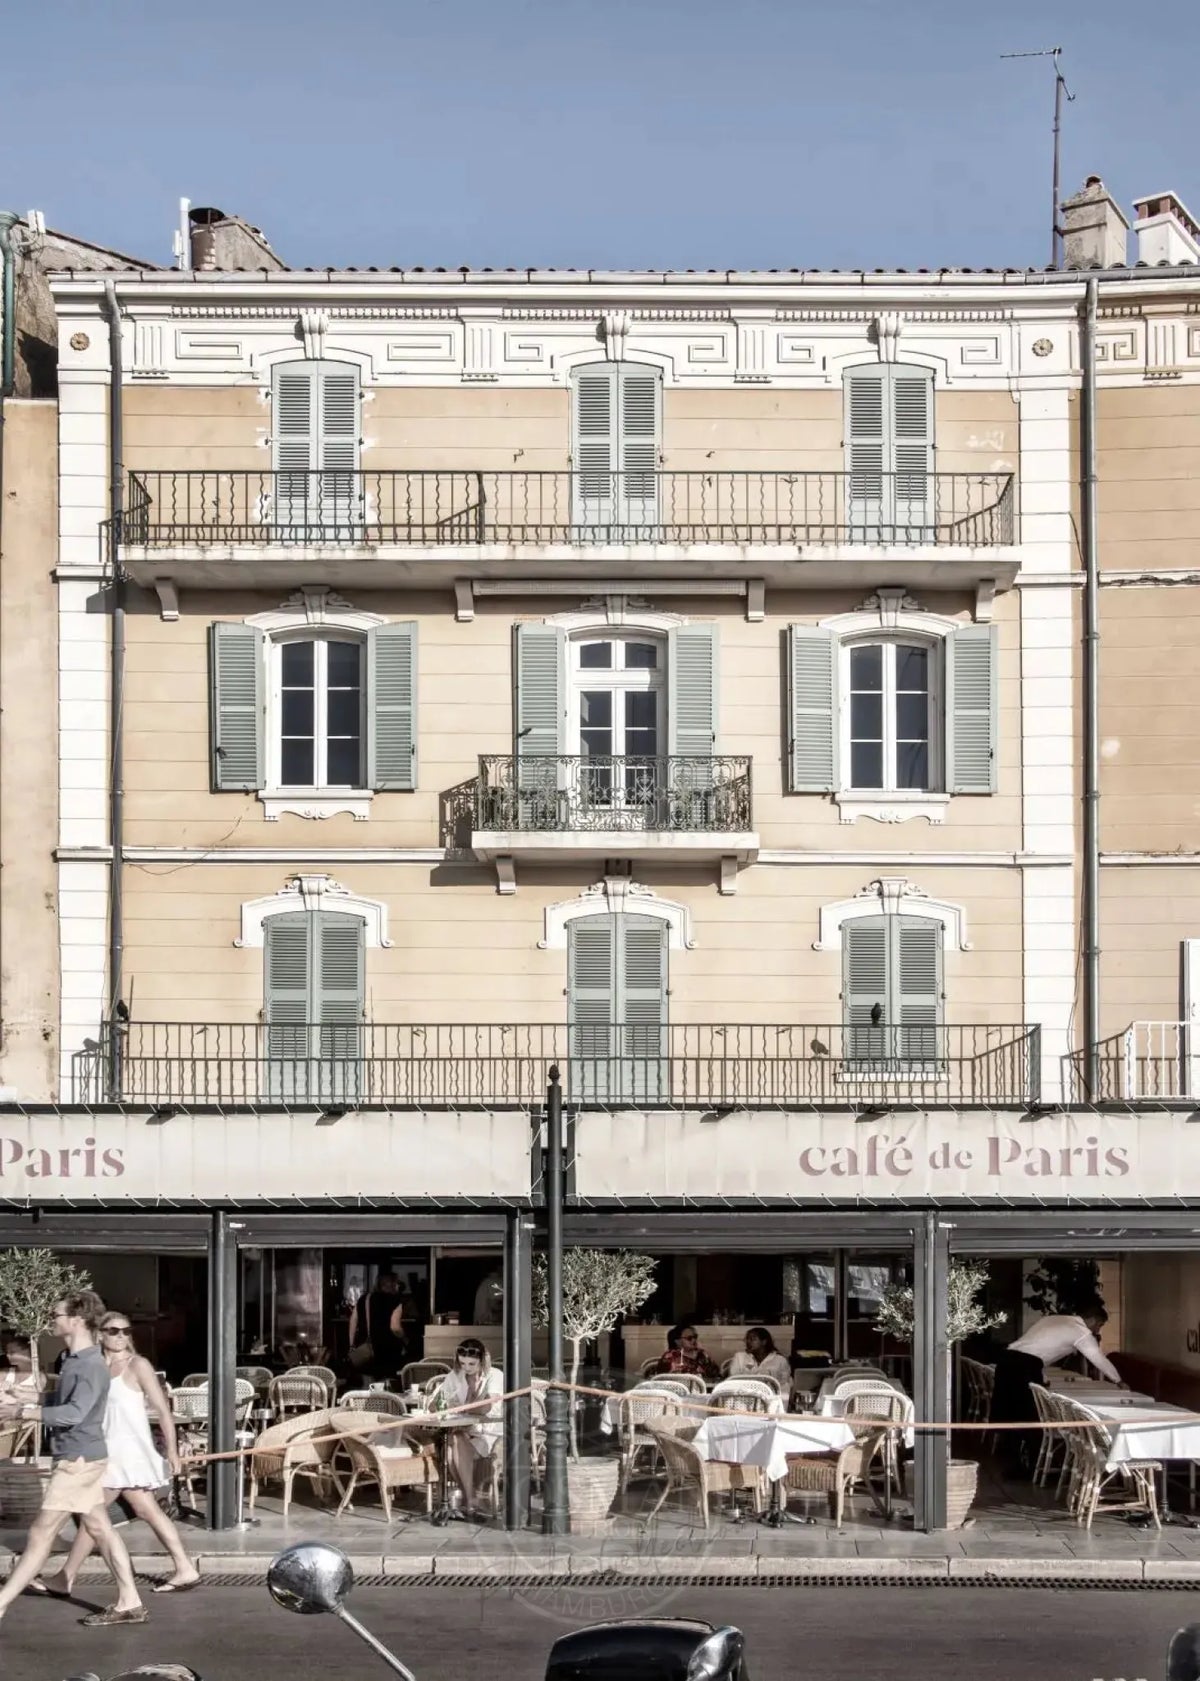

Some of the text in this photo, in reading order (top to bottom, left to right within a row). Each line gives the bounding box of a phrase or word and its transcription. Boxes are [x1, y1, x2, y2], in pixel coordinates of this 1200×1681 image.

[0, 1137, 125, 1178] Paris
[799, 1134, 1130, 1177] café de Paris
